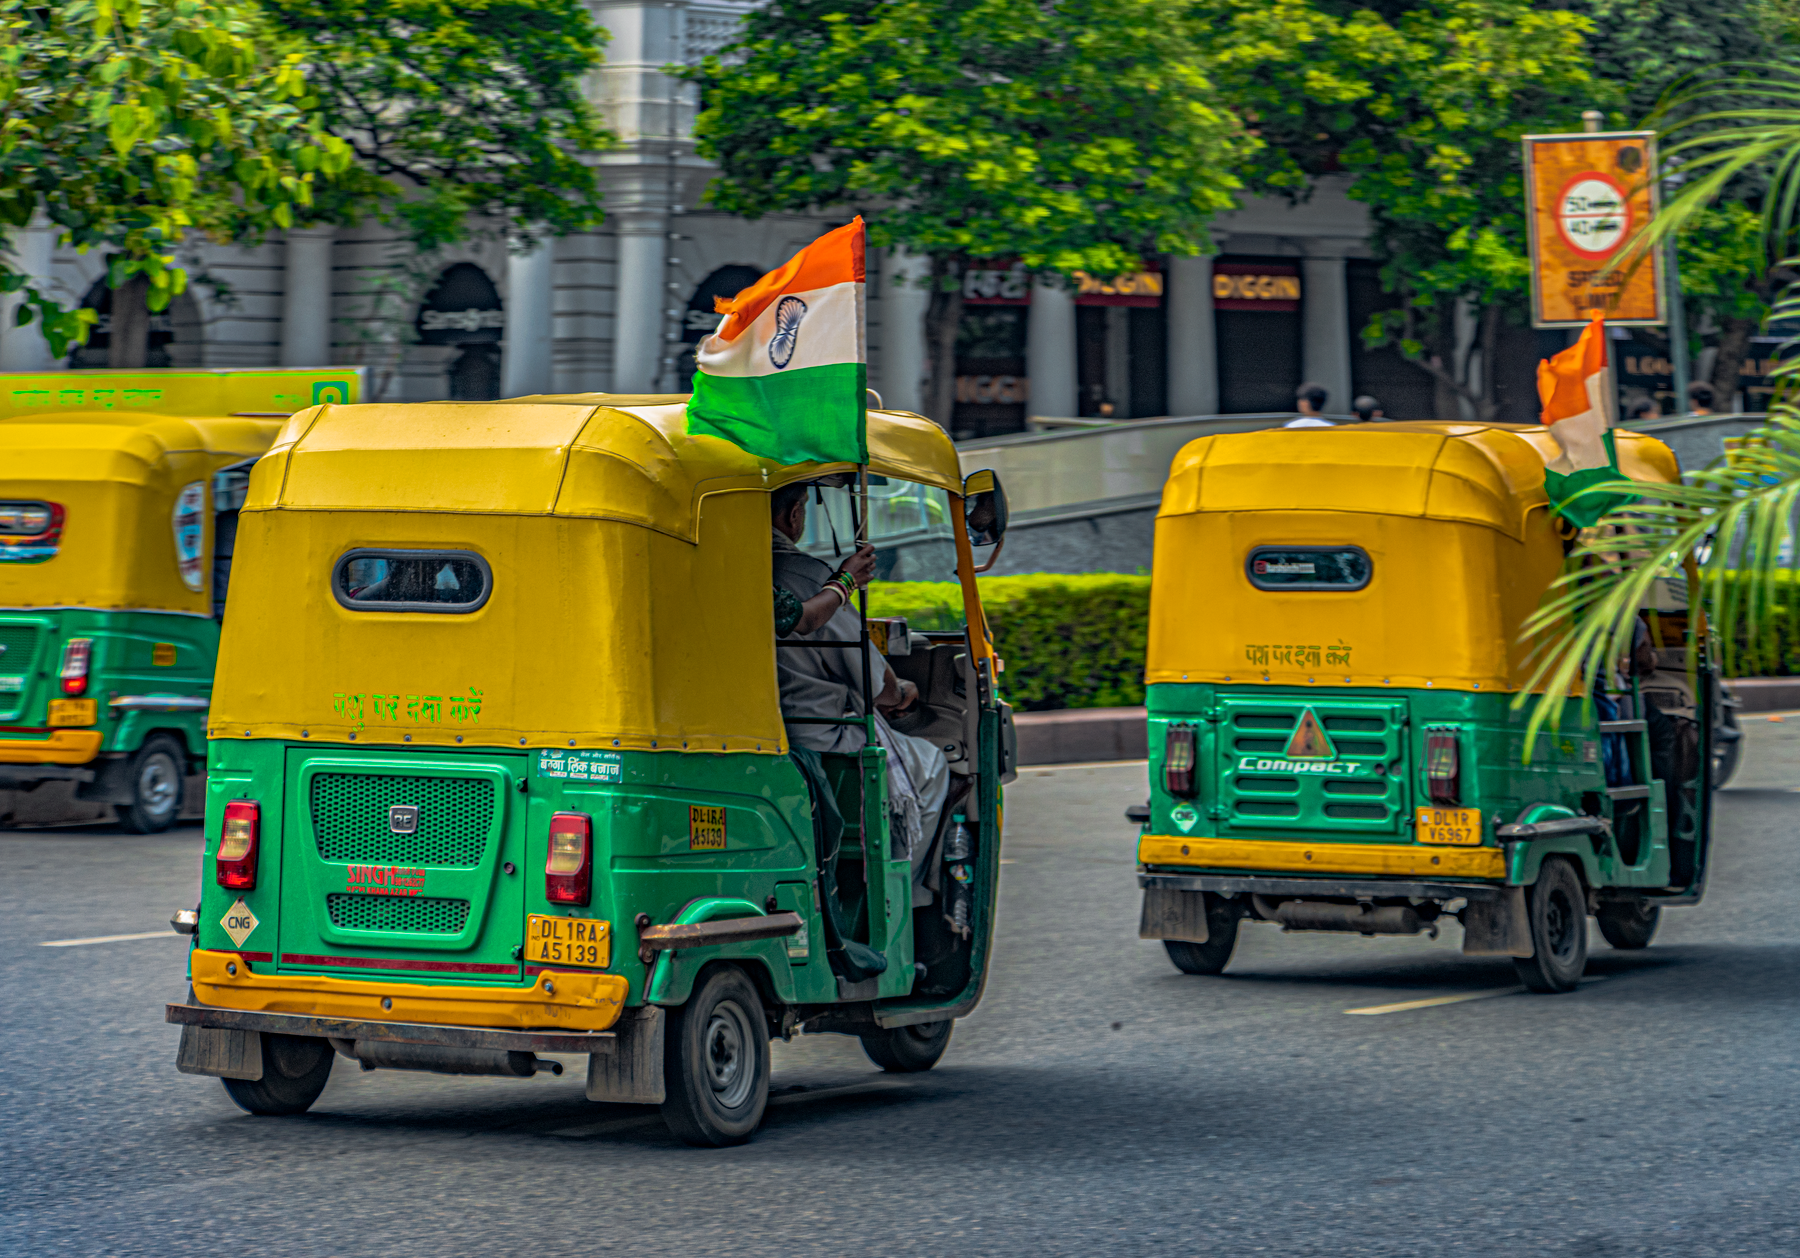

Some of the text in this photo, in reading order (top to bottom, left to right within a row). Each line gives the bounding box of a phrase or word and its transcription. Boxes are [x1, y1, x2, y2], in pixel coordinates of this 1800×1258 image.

[567, 756, 588, 773] लिंक
[590, 761, 620, 776] बजाज
[394, 814, 412, 828] RE
[692, 827, 723, 848] A5139
[1429, 827, 1471, 842] V6967
[347, 864, 395, 886] SINGH
[228, 916, 250, 929] CNG
[540, 941, 598, 963] A5139
